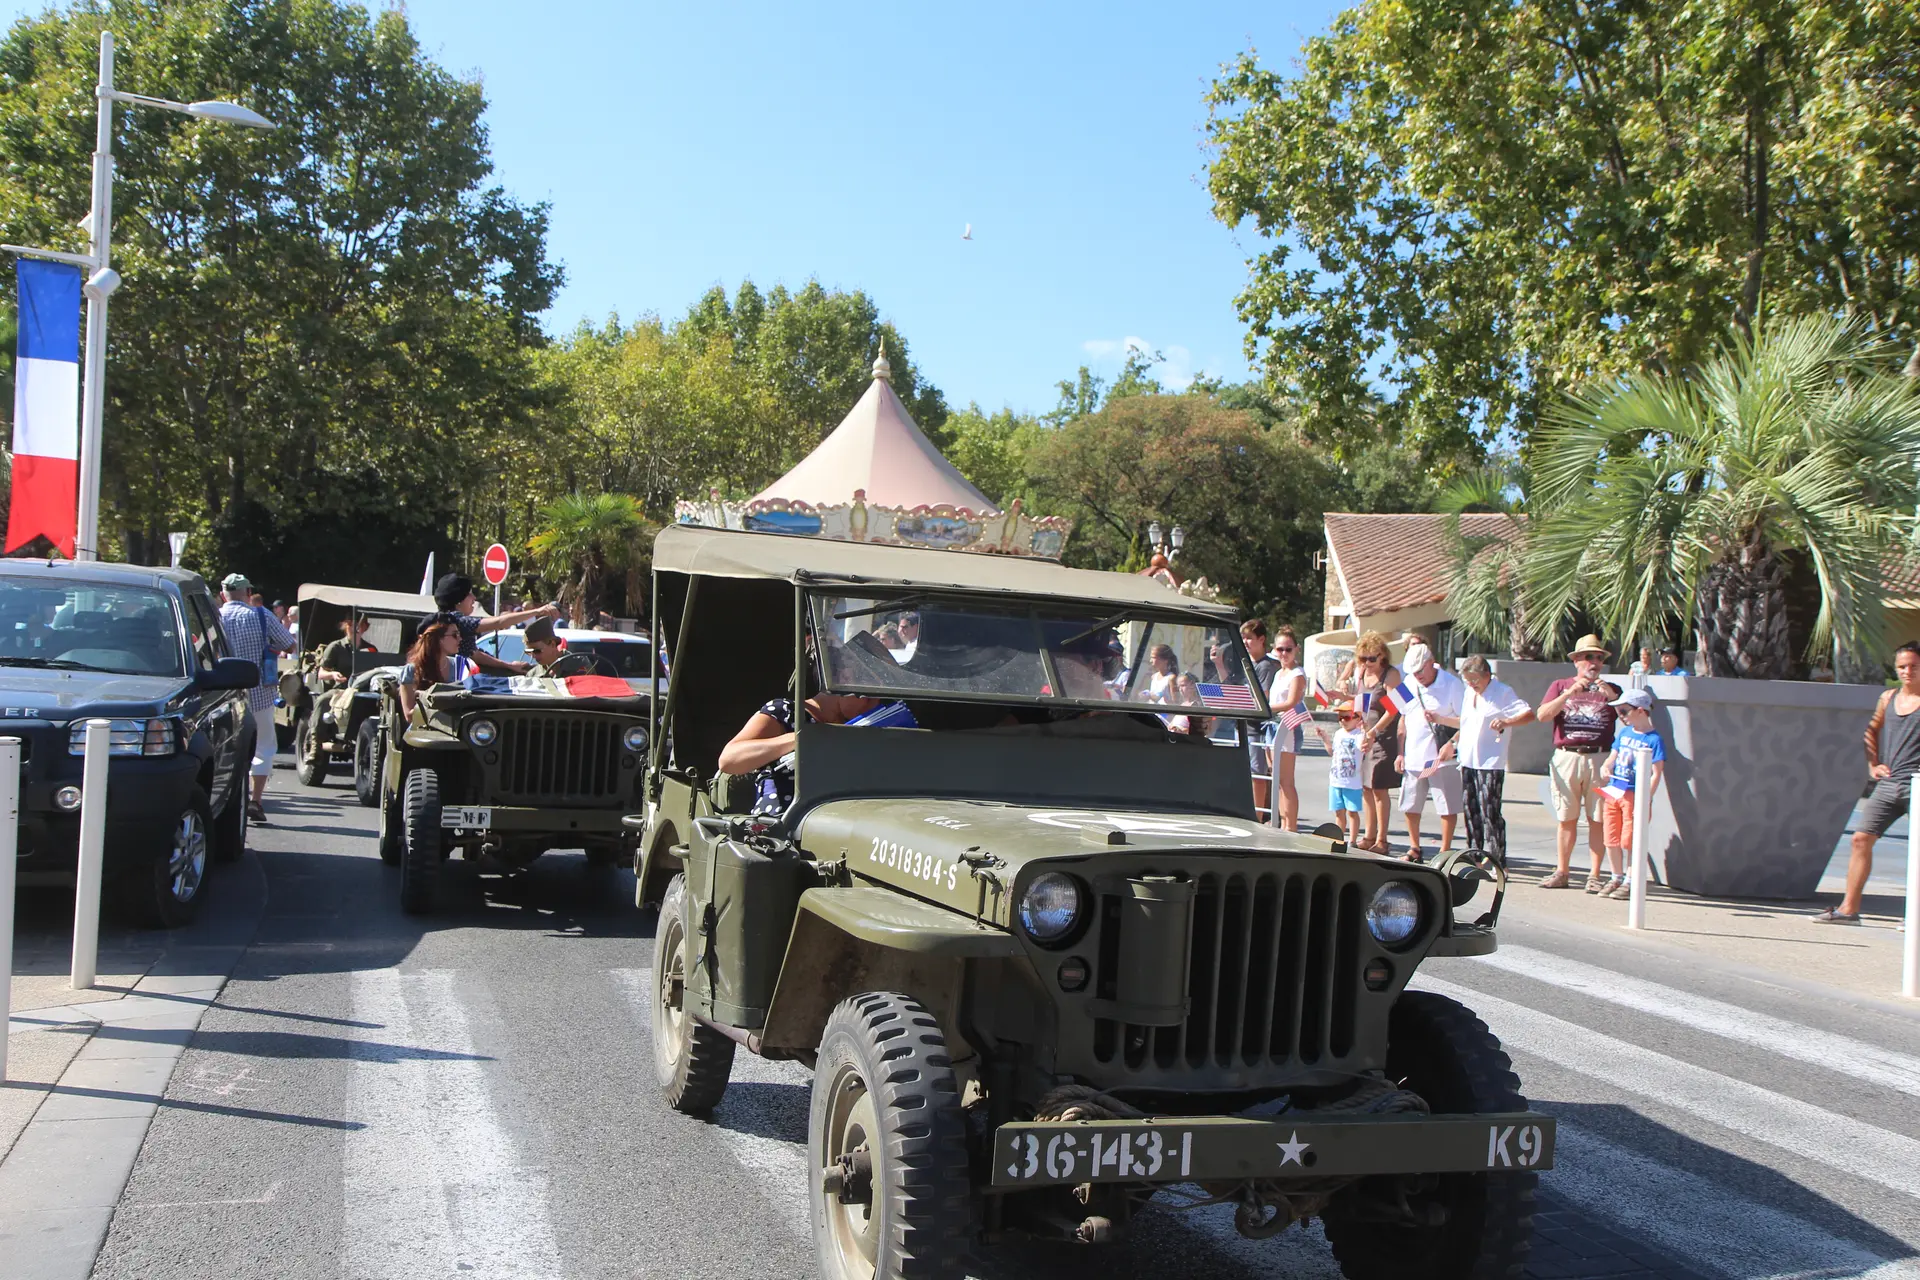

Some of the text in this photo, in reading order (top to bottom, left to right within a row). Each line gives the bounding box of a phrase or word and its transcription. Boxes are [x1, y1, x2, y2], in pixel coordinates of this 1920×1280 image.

[5, 707, 40, 717] ER
[869, 836, 958, 891] 20318384-S
[1487, 1125, 1543, 1167] K9
